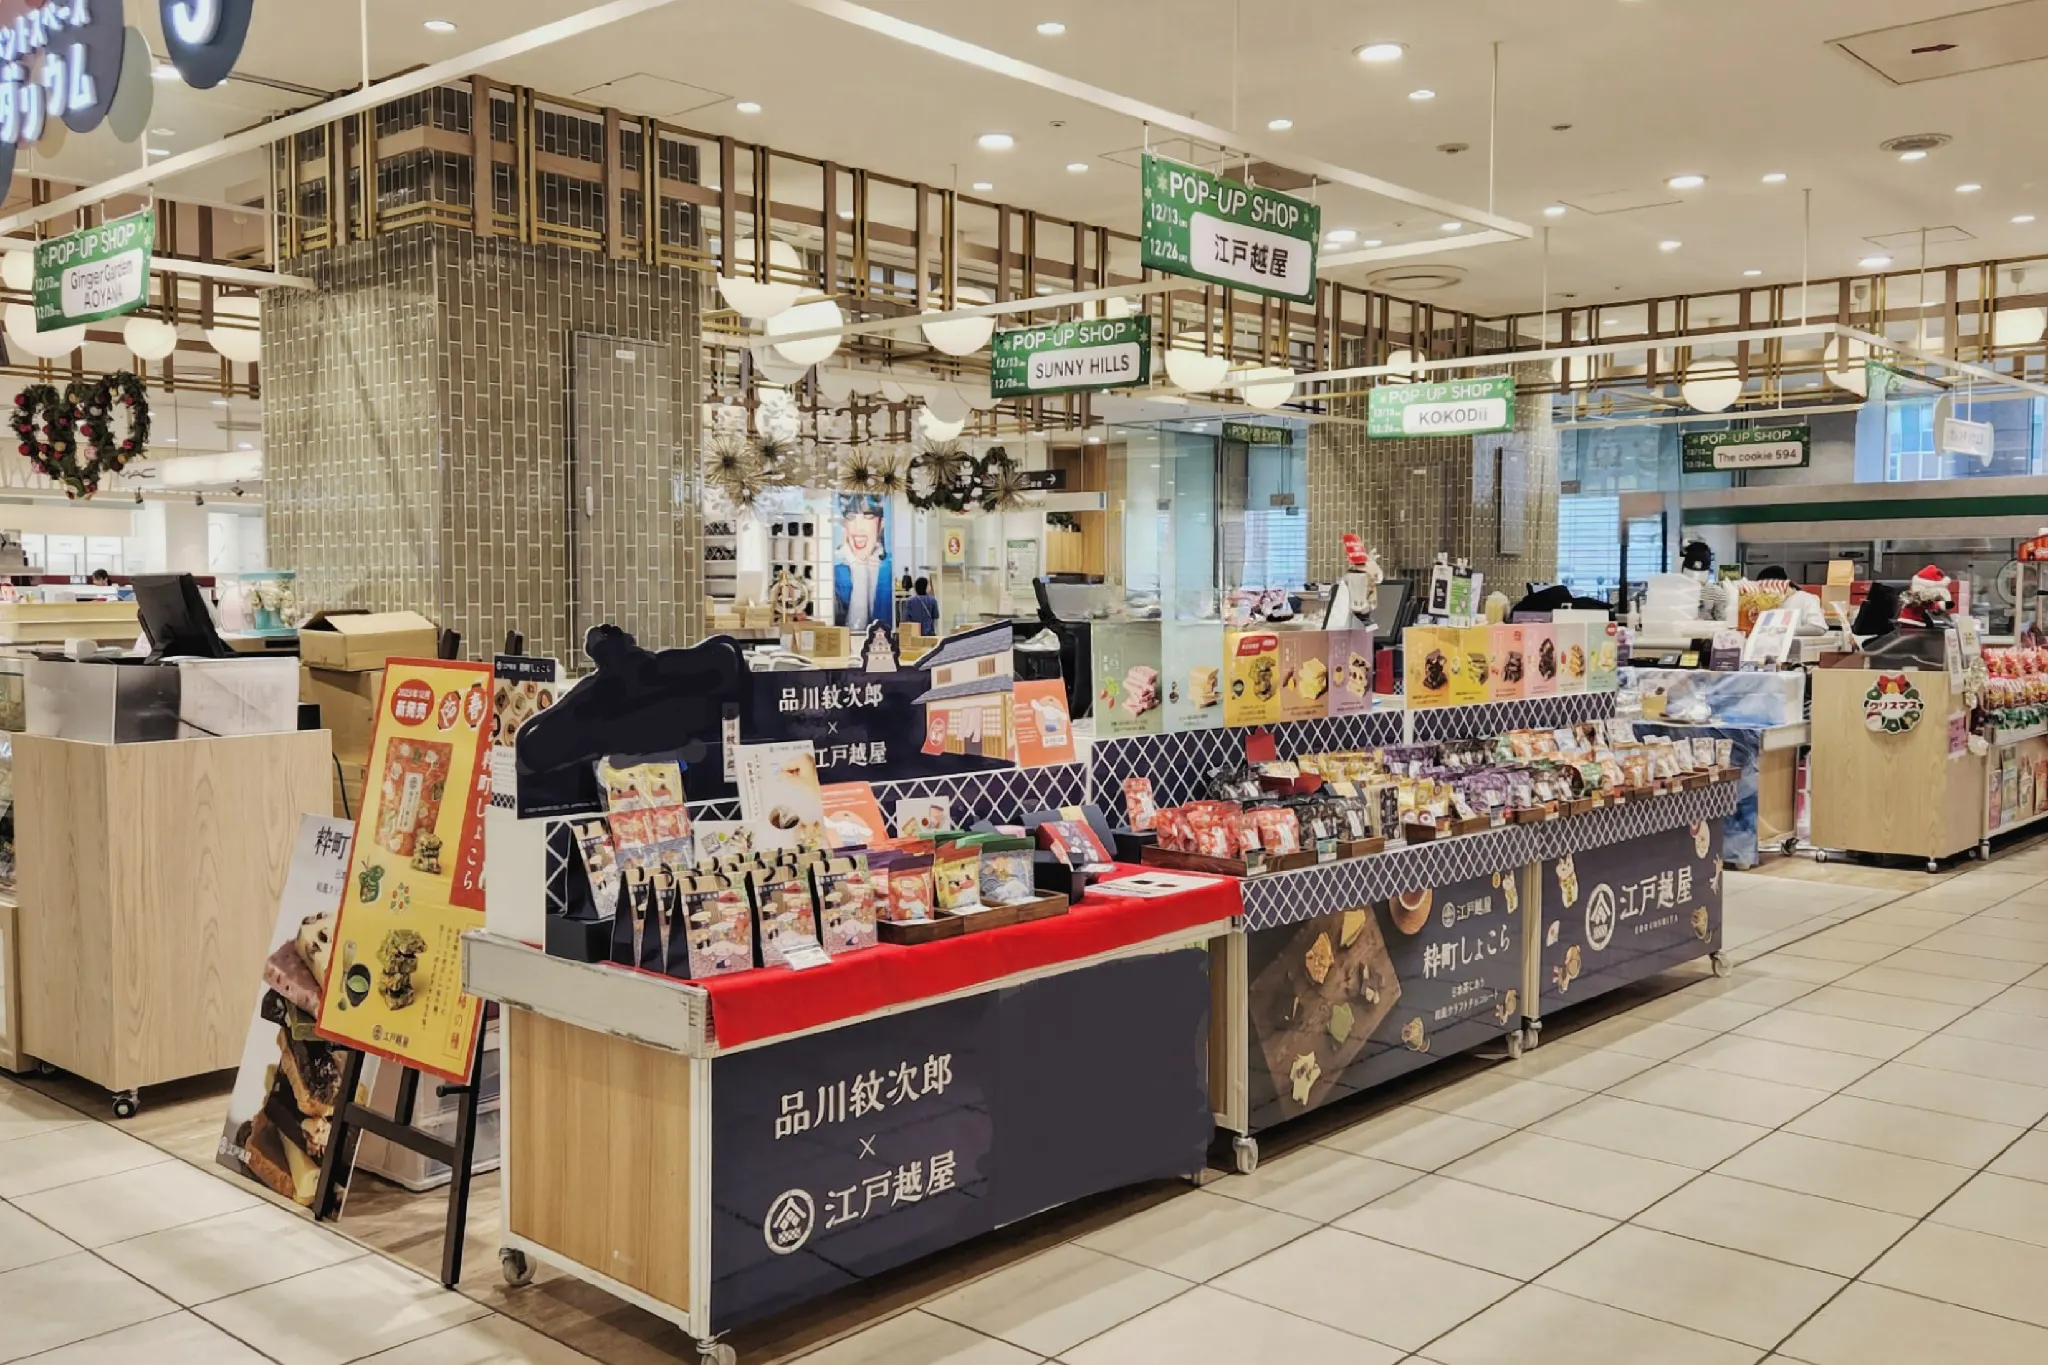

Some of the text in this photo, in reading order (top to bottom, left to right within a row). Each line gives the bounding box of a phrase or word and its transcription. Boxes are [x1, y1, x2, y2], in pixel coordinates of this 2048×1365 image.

[1169, 170, 1299, 229] POP-UP SHOP
[48, 222, 136, 267] POP-UP SHOP
[1214, 233, 1289, 278] 江戸越屋
[1012, 322, 1126, 351] POP-UP SHOP
[1035, 354, 1130, 379] SUNNY HILLS
[1388, 383, 1493, 404] POP-UP SHOP
[1419, 407, 1488, 425] KOKODii
[1700, 430, 1792, 445] POP-UP SHOP
[1718, 449, 1797, 463] The cookie 594
[779, 682, 884, 713] 品川紋次郎
[1869, 701, 1918, 711] クリスマス
[1620, 865, 1693, 920] 江戸越屋
[1456, 895, 1492, 921] 江戸越屋
[1422, 923, 1511, 980] 粋町しょこら
[774, 1053, 953, 1140] 品川紋次郎
[824, 1149, 957, 1229] 江戸越屋
